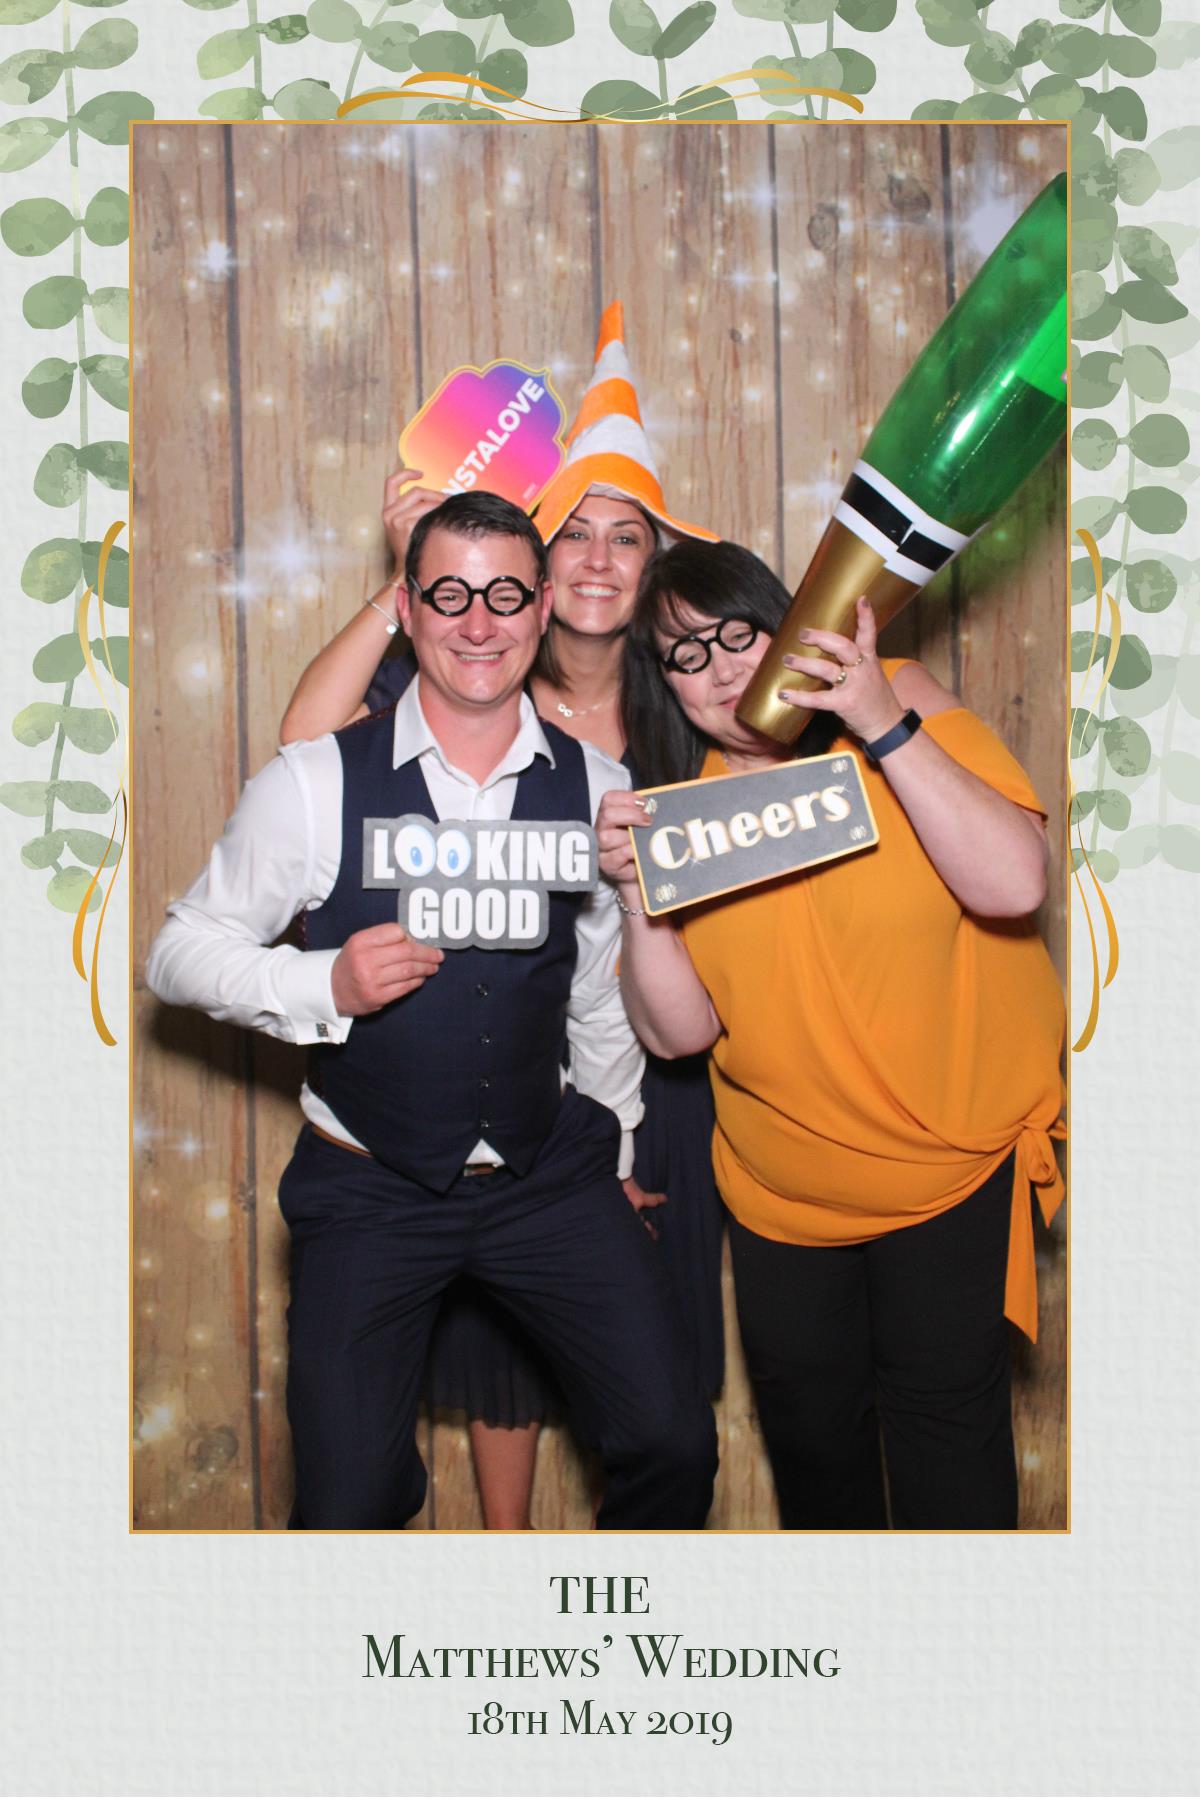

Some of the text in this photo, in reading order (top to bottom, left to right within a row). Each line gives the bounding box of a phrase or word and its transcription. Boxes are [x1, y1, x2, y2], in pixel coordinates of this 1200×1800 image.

[441, 377, 545, 496] NSTALOVE
[373, 824, 590, 882] LOOKING
[650, 785, 851, 870] Cheers
[408, 887, 540, 940] GOOD
